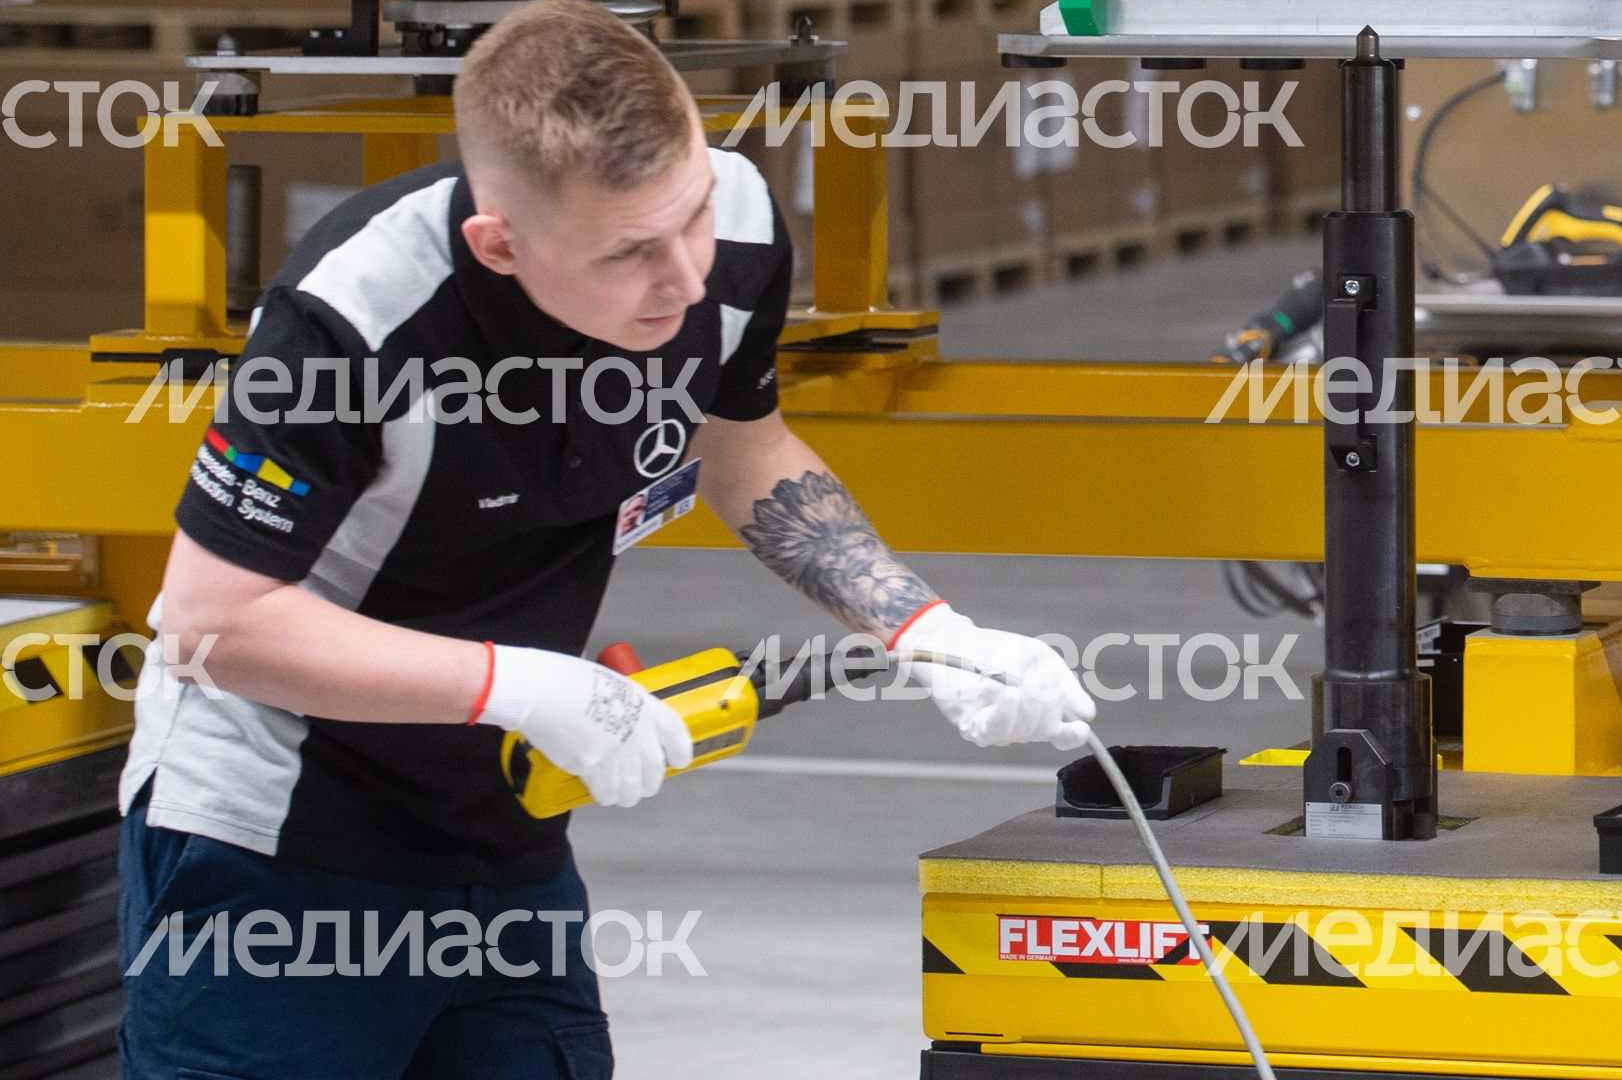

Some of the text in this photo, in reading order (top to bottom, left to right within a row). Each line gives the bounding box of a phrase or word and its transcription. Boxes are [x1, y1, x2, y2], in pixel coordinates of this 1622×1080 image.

[237, 498, 295, 534] System
[999, 918, 1210, 960] FLEXLIFT
[1000, 953, 1017, 961] MADE
[1026, 954, 1057, 962] GERMANY
